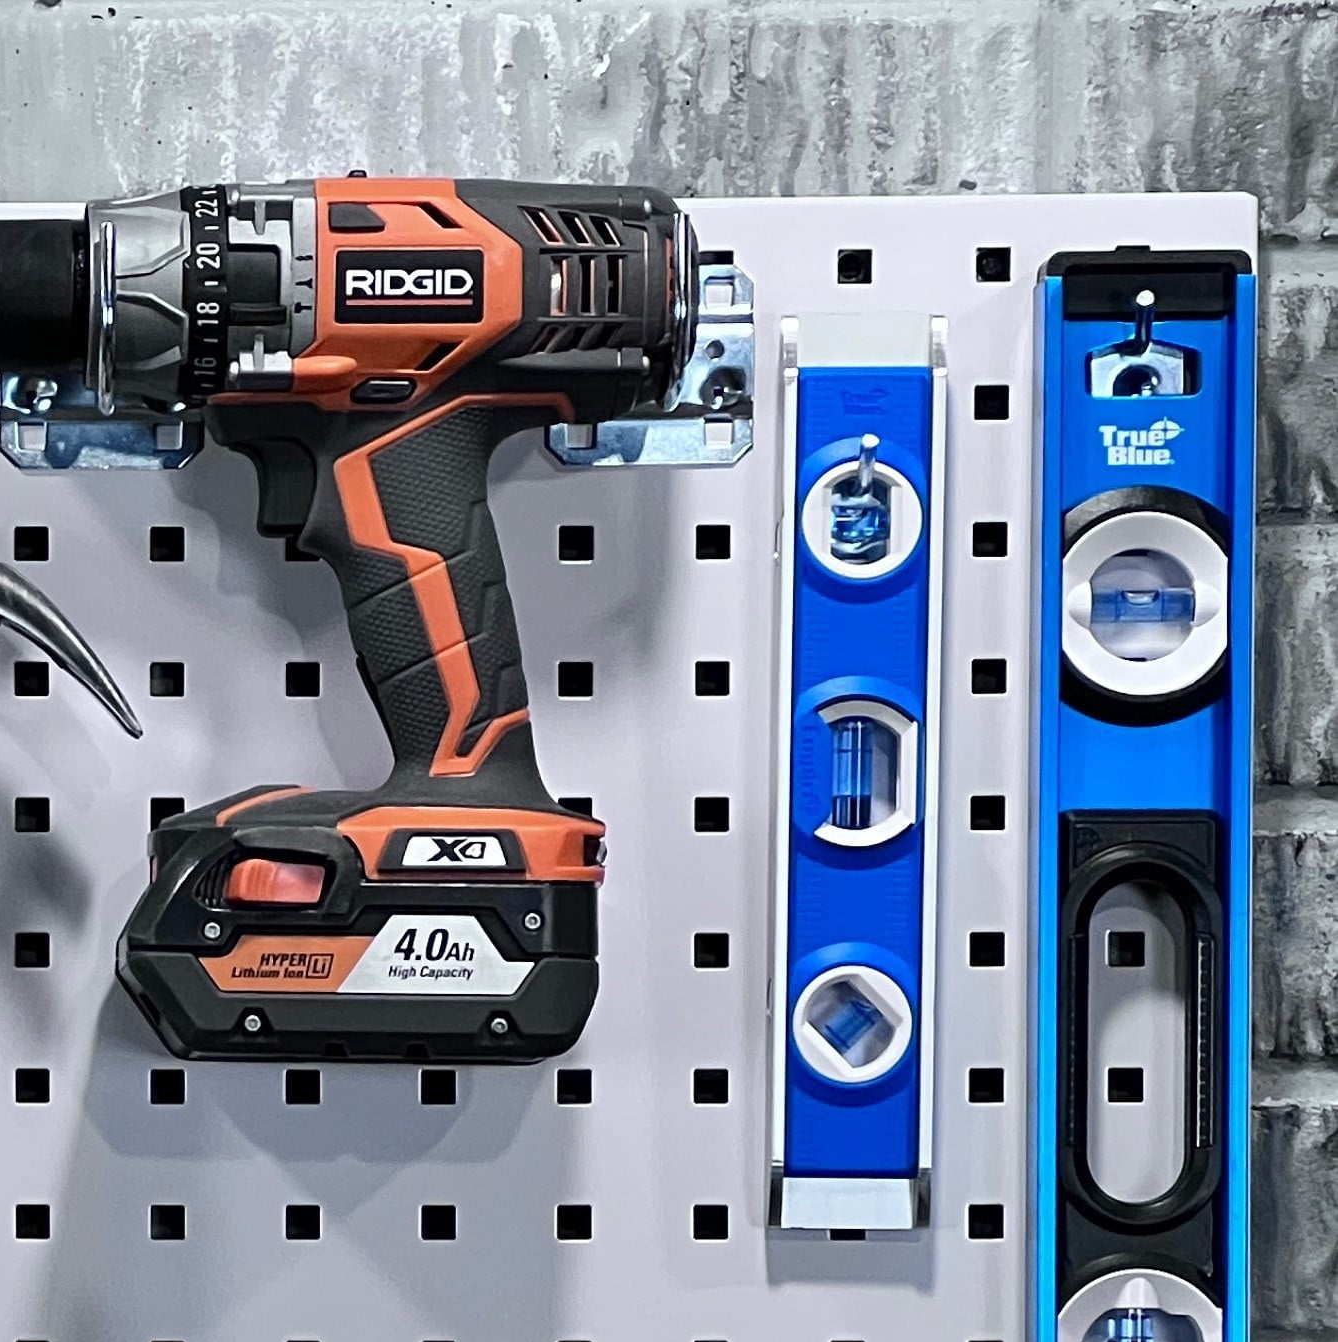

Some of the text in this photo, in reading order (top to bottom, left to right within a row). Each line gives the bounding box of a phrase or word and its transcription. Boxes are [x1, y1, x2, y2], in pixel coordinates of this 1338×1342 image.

[195, 198, 219, 218] 22
[196, 242, 221, 269] 20
[345, 269, 474, 296] RIDGID
[197, 301, 220, 327] 18
[194, 357, 217, 375] 16
[1099, 425, 1166, 446] True
[1108, 446, 1171, 465] Blue
[393, 928, 475, 962] 4.0Ah
[259, 953, 307, 967] HYPER
[231, 966, 305, 978] Lithium Ion
[388, 965, 474, 981] High Capacity
